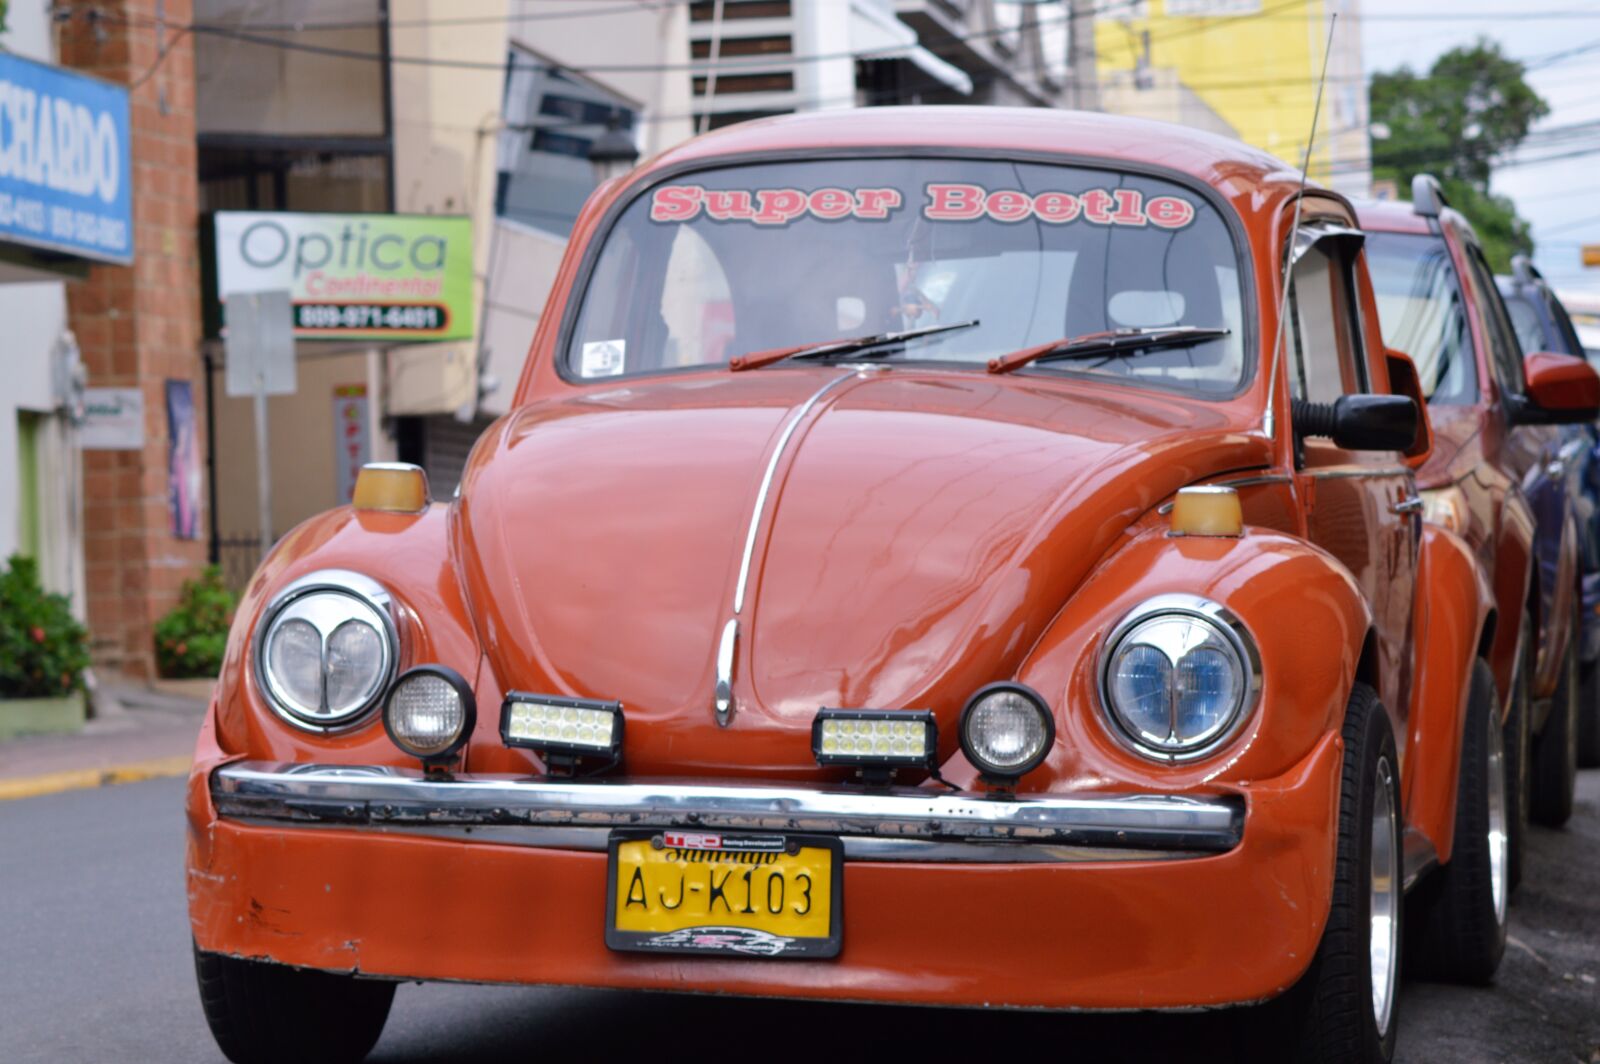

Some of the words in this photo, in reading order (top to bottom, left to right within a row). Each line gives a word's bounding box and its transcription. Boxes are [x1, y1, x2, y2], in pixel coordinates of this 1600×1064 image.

[650, 184, 902, 225] Super
[924, 183, 1195, 229] Beetle
[240, 220, 448, 281] Optica
[305, 271, 442, 298] Continental
[625, 866, 812, 915] AJ-K103
